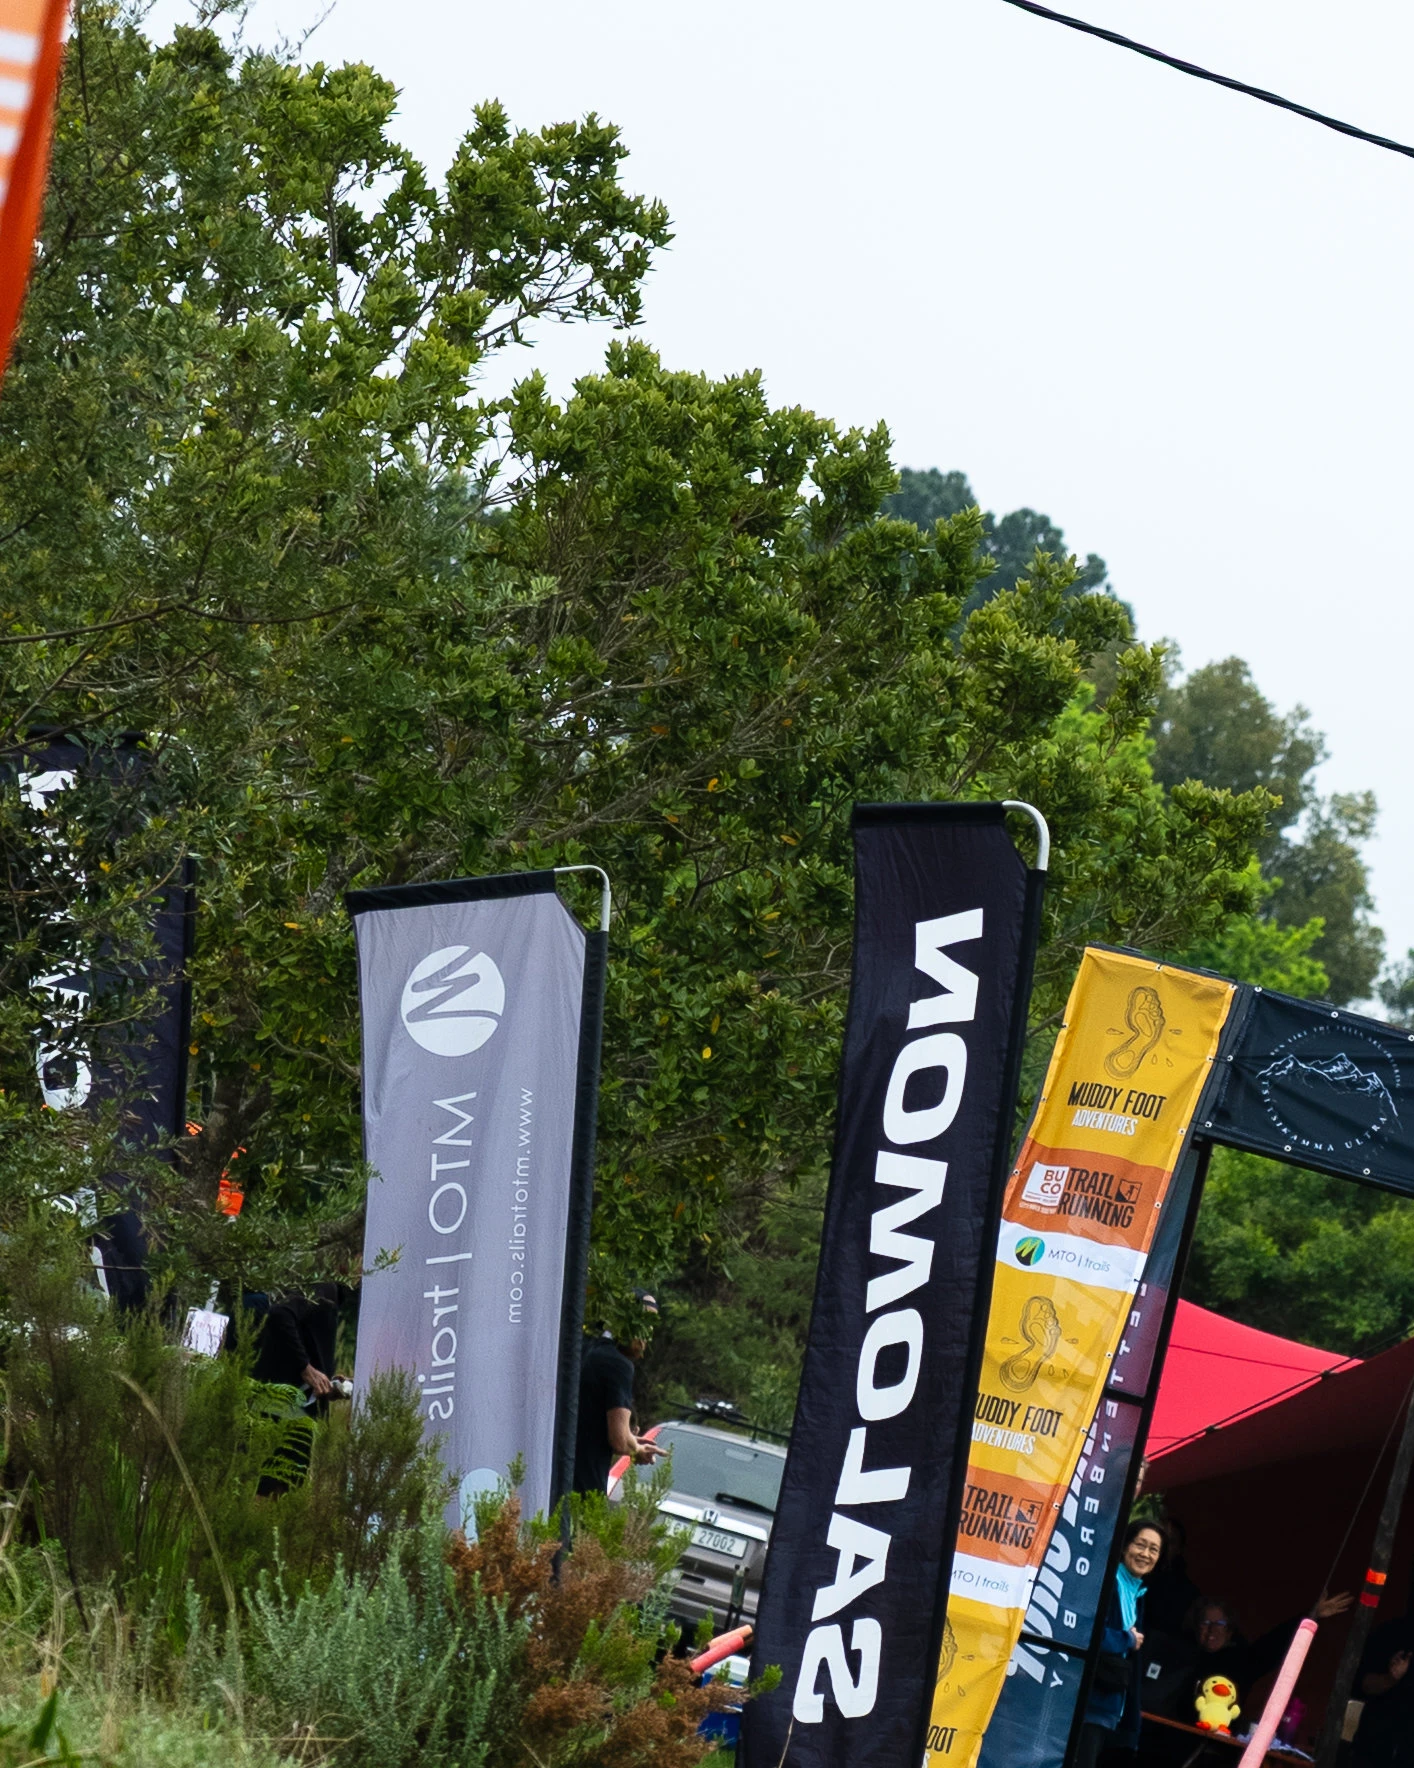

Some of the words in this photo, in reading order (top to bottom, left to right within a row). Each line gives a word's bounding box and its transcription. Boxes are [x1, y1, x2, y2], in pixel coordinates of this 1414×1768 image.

[1067, 1081, 1124, 1114] MUDDY
[1122, 1090, 1167, 1121] FOOT
[1072, 1109, 1138, 1136] ADVENTURES
[1040, 1182, 1062, 1195] CO
[1044, 1169, 1066, 1182] BU
[1065, 1167, 1115, 1200] TRAIL
[1057, 1191, 1136, 1229] RUNNING
[1048, 1248, 1077, 1264] MTO
[1084, 1257, 1111, 1273] trails
[974, 1392, 1021, 1428] UDDY
[1021, 1406, 1064, 1438] FOOT
[966, 1484, 1014, 1523] TRAIL
[698, 1530, 736, 1553] 27002
[982, 1576, 1010, 1592] trails
[926, 1725, 958, 1754] OOT
